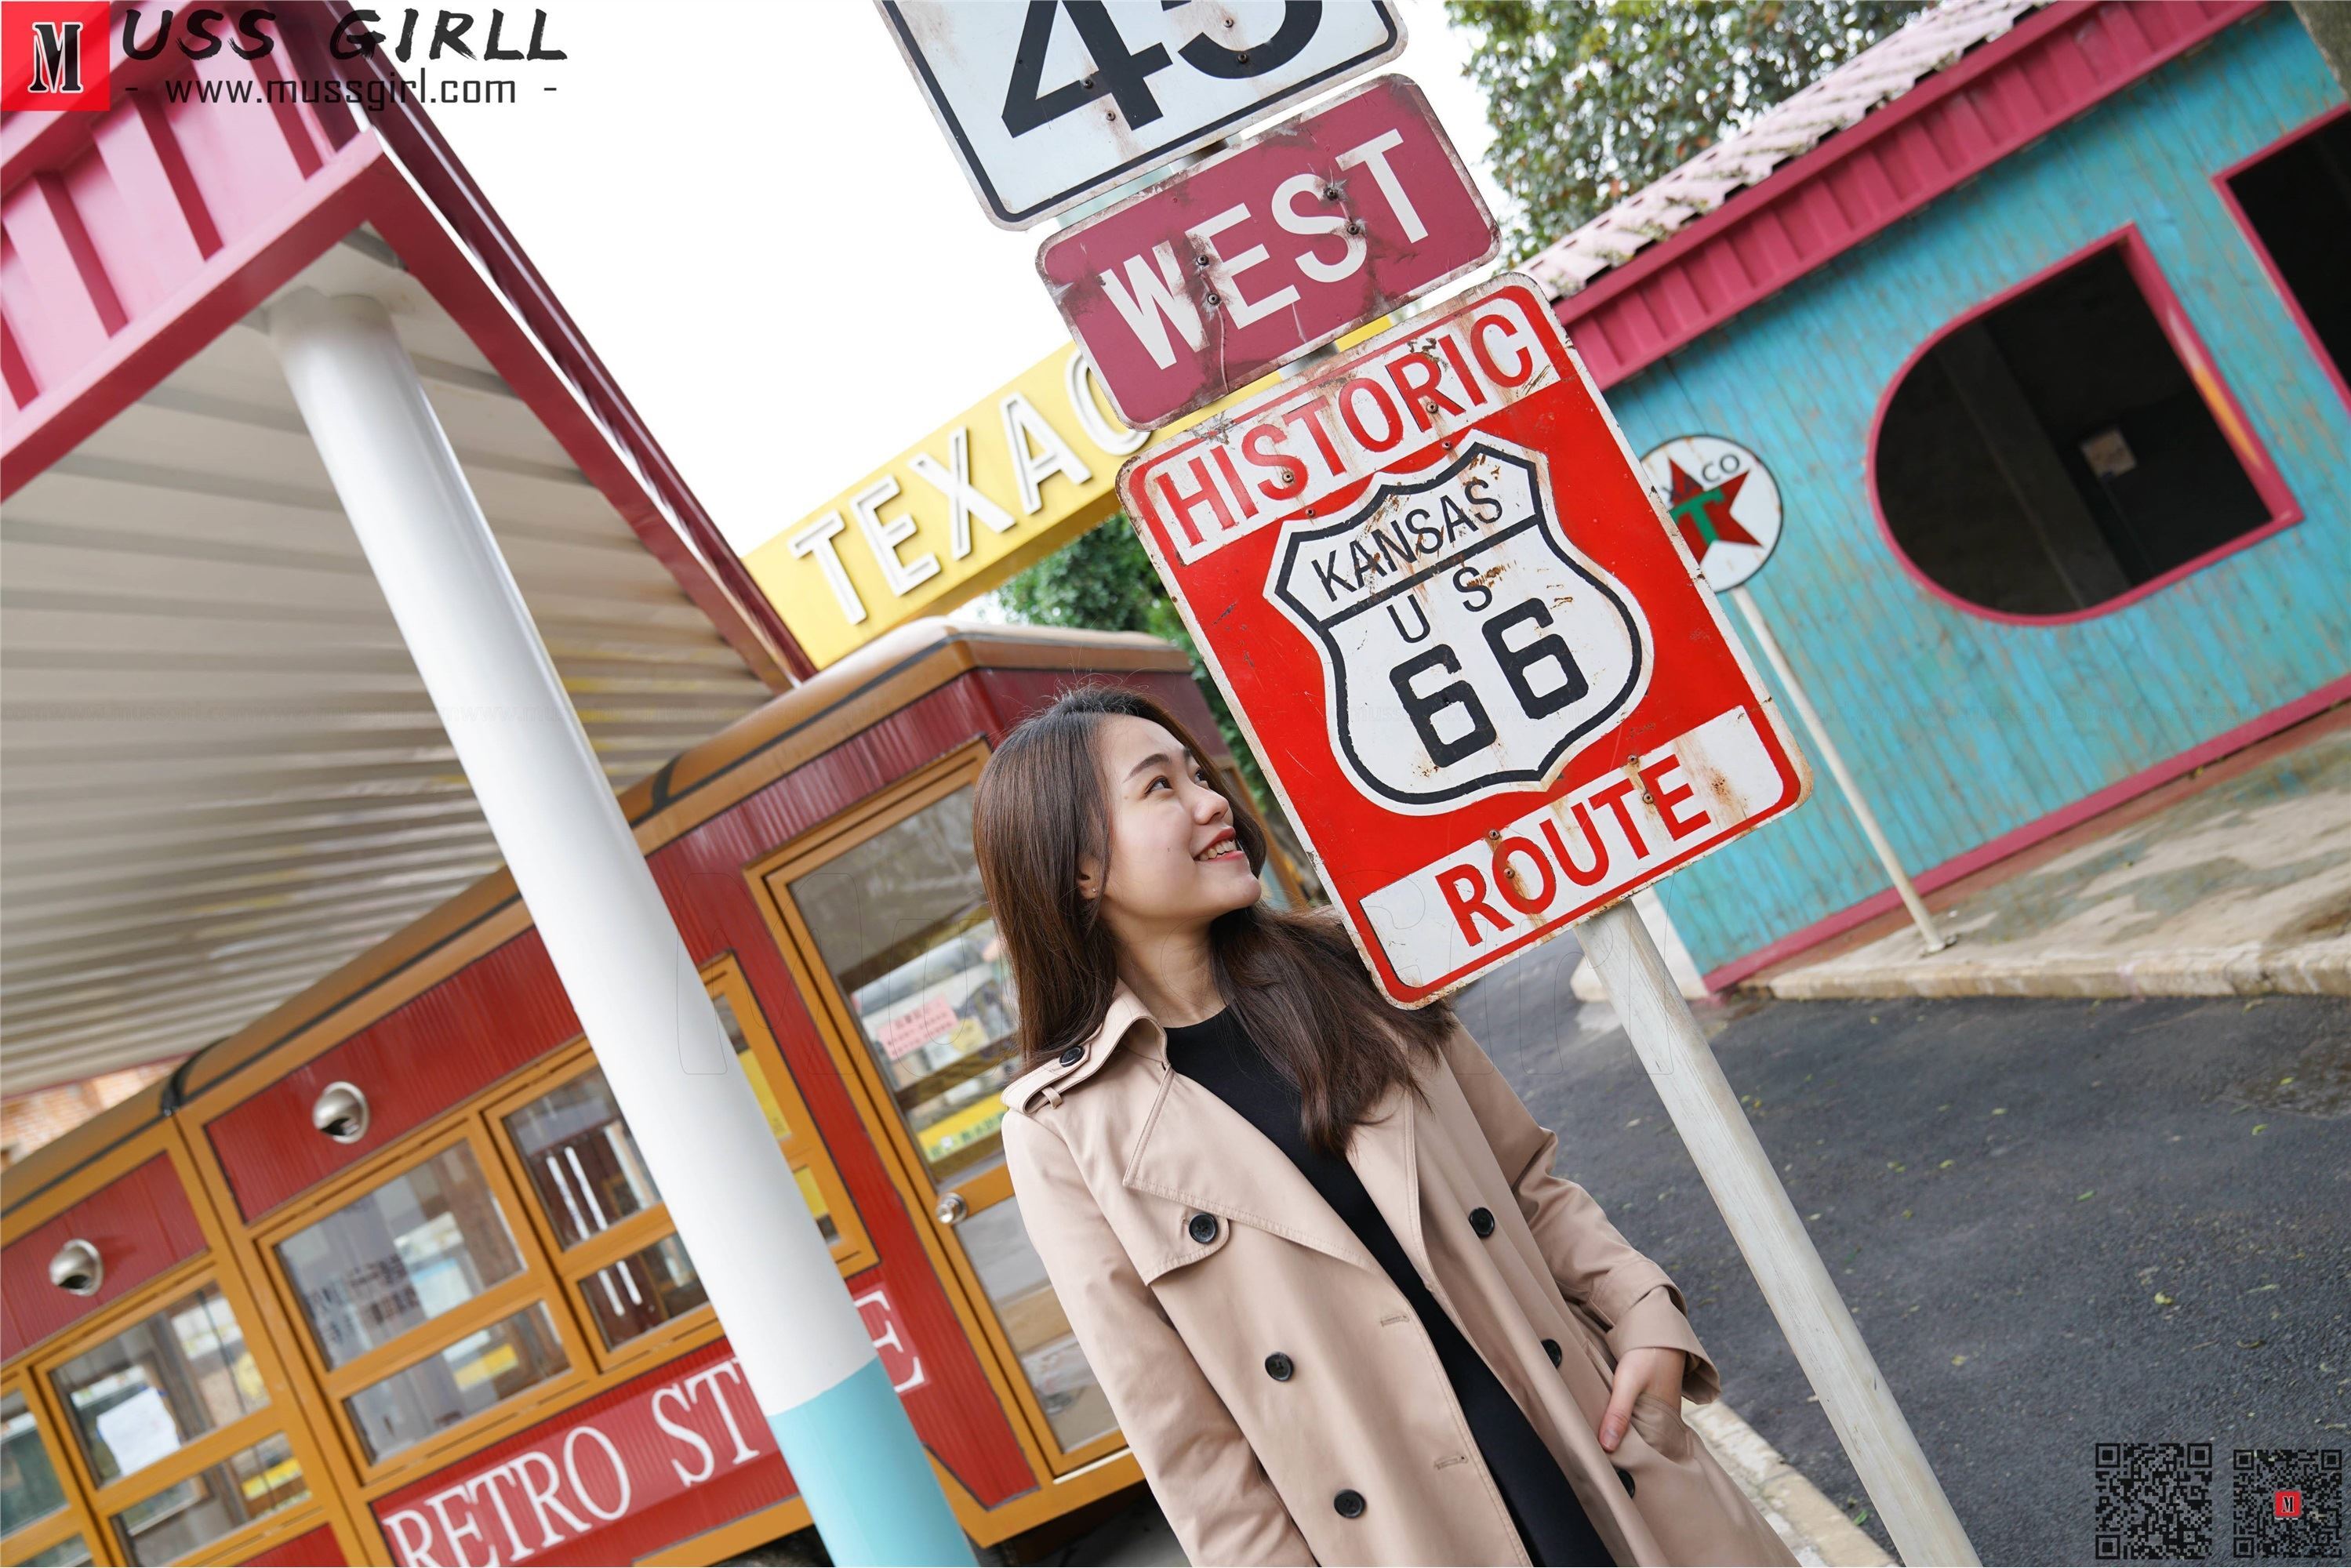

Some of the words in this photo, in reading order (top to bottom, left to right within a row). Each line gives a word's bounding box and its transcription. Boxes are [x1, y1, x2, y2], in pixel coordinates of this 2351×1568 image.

[1099, 129, 1429, 370] WEST
[787, 348, 1154, 626] TEXAC
[1157, 314, 1533, 545] HISTORIC
[1311, 479, 1503, 602] KANSAS
[1390, 597, 1590, 768] 66
[1435, 754, 1712, 947] ROUTE
[382, 1425, 630, 1567] RETRO
[651, 1290, 925, 1486] STE
